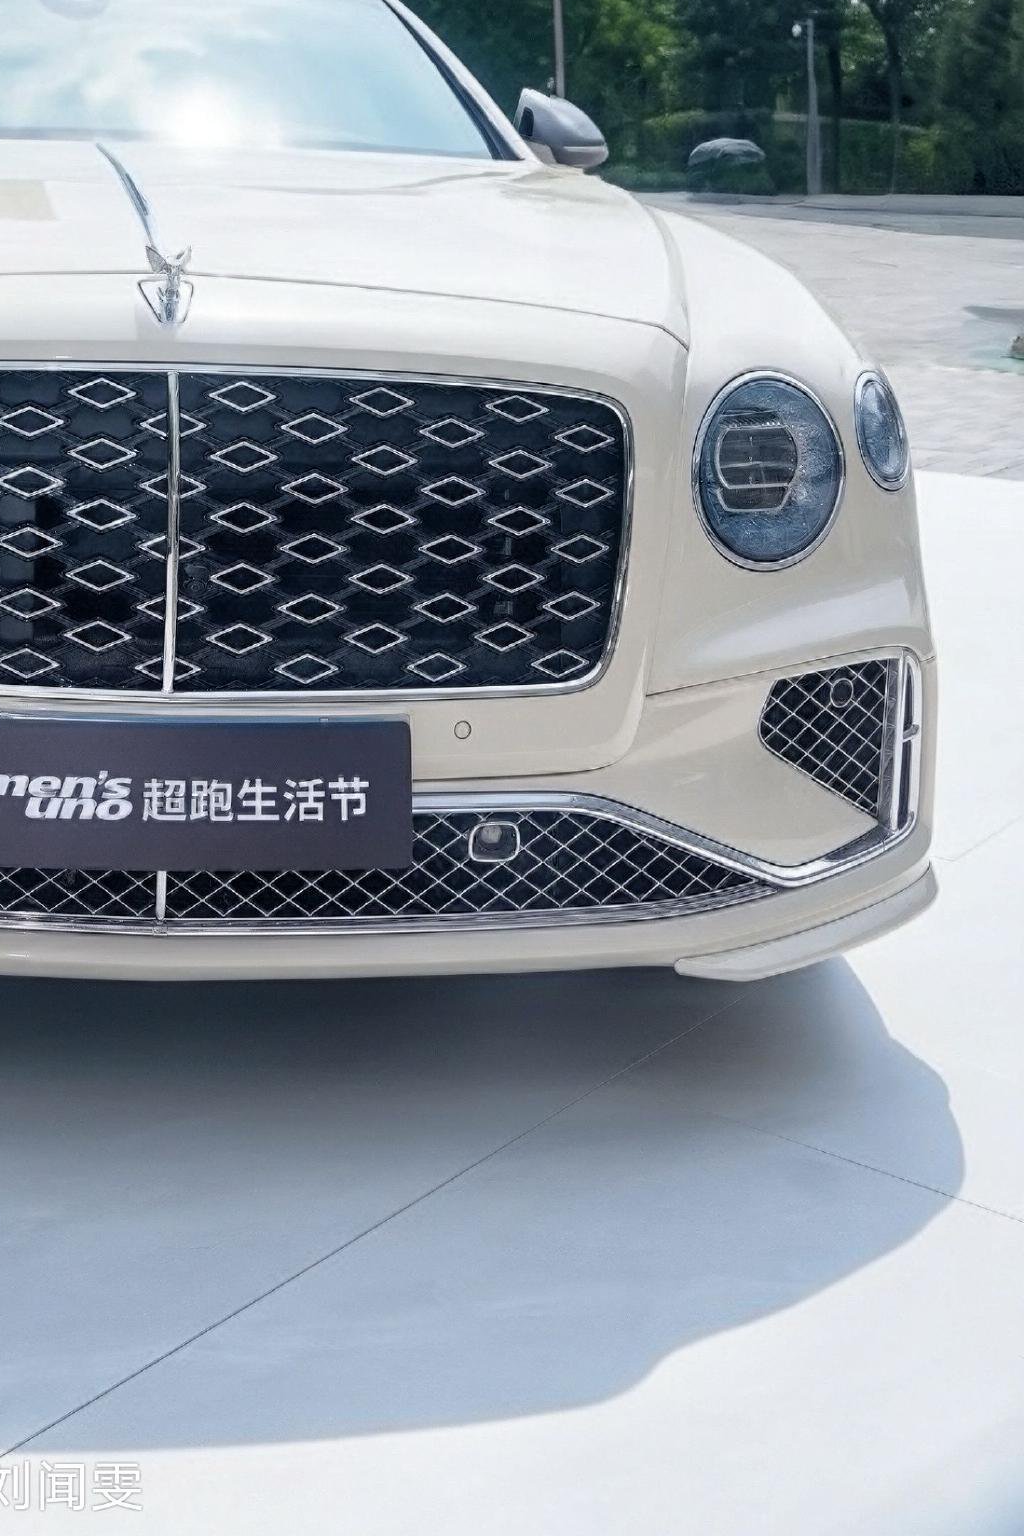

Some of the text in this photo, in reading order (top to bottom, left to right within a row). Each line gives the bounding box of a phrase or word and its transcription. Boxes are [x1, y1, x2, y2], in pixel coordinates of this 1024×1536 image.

[24, 796, 133, 821] uno
[142, 776, 370, 822] 超跑生活节
